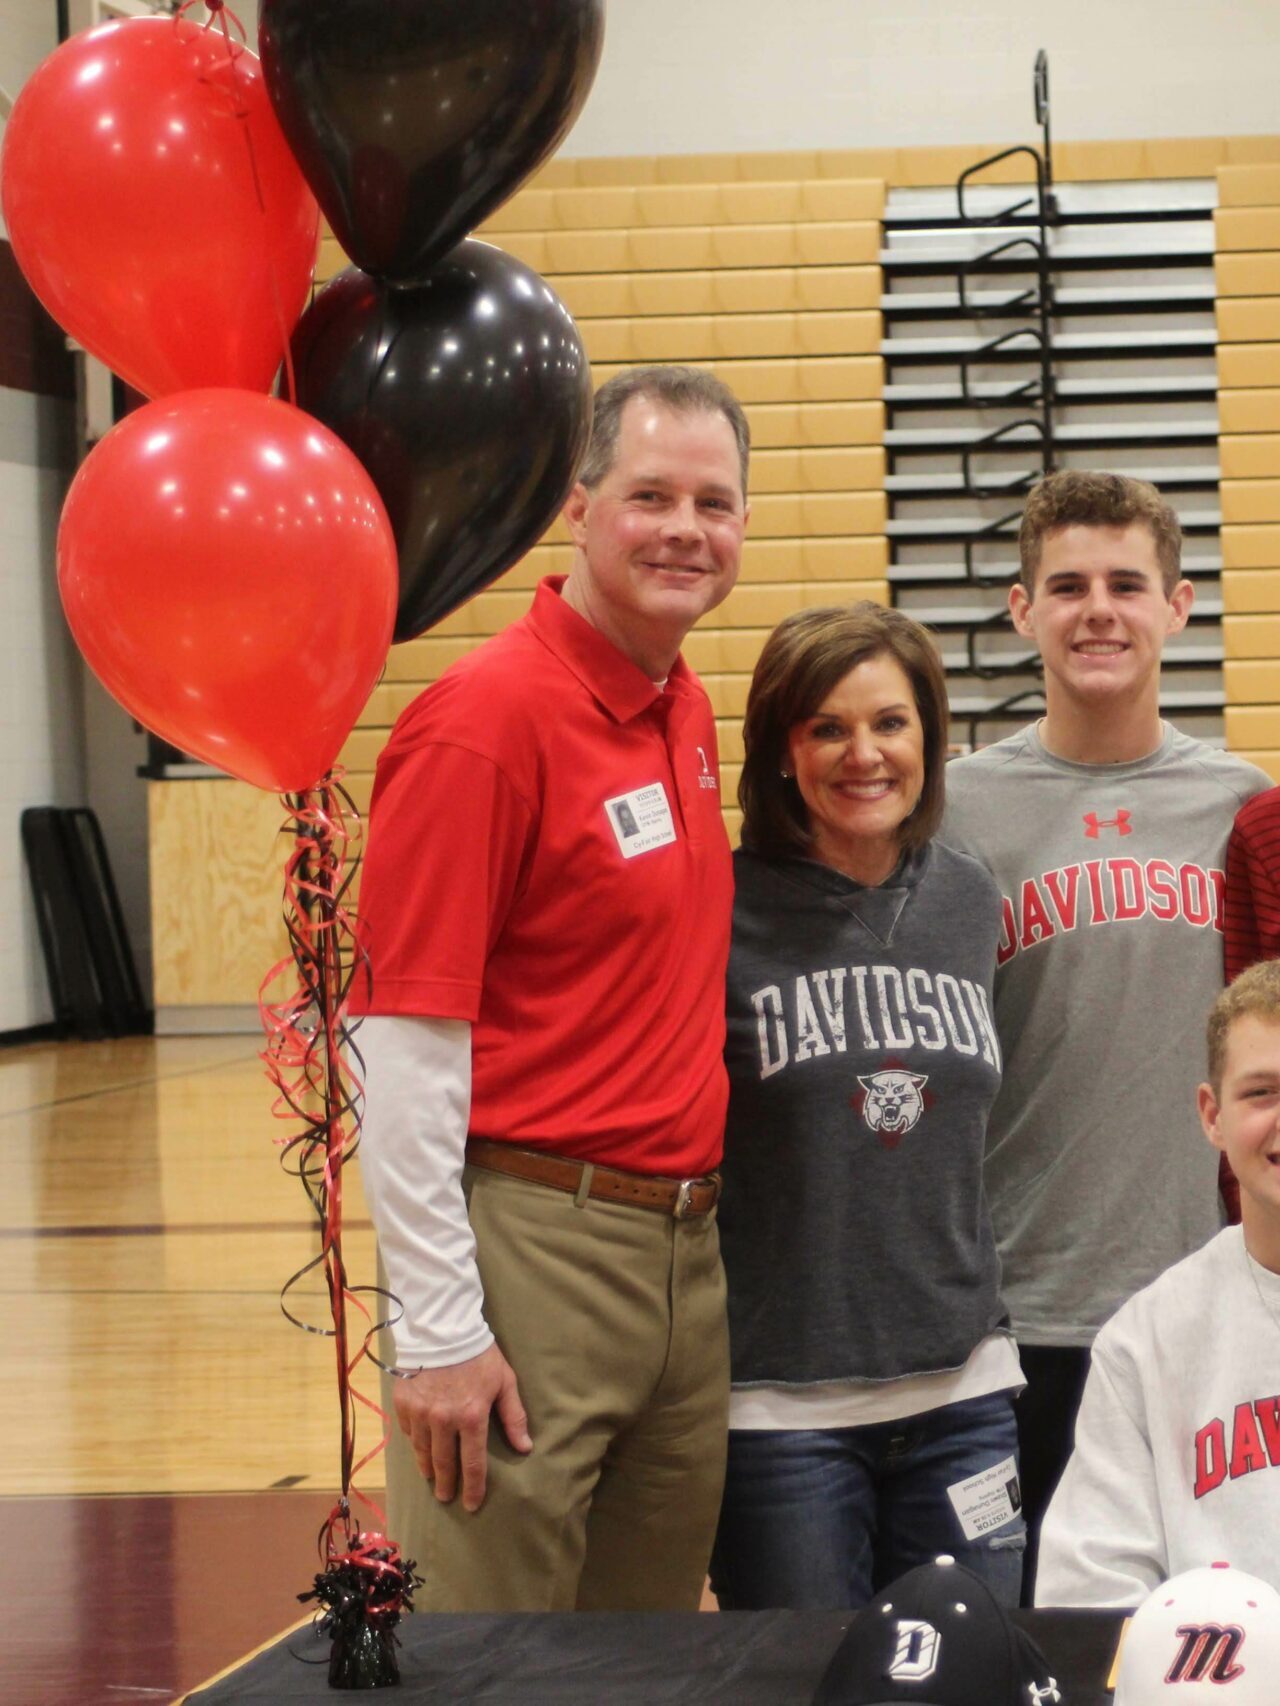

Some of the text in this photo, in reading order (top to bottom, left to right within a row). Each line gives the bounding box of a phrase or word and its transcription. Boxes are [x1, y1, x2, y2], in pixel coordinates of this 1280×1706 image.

[751, 966, 1002, 1080] DAVIDSON
[976, 1511, 1008, 1531] VISITOR
[889, 1621, 942, 1680] D
